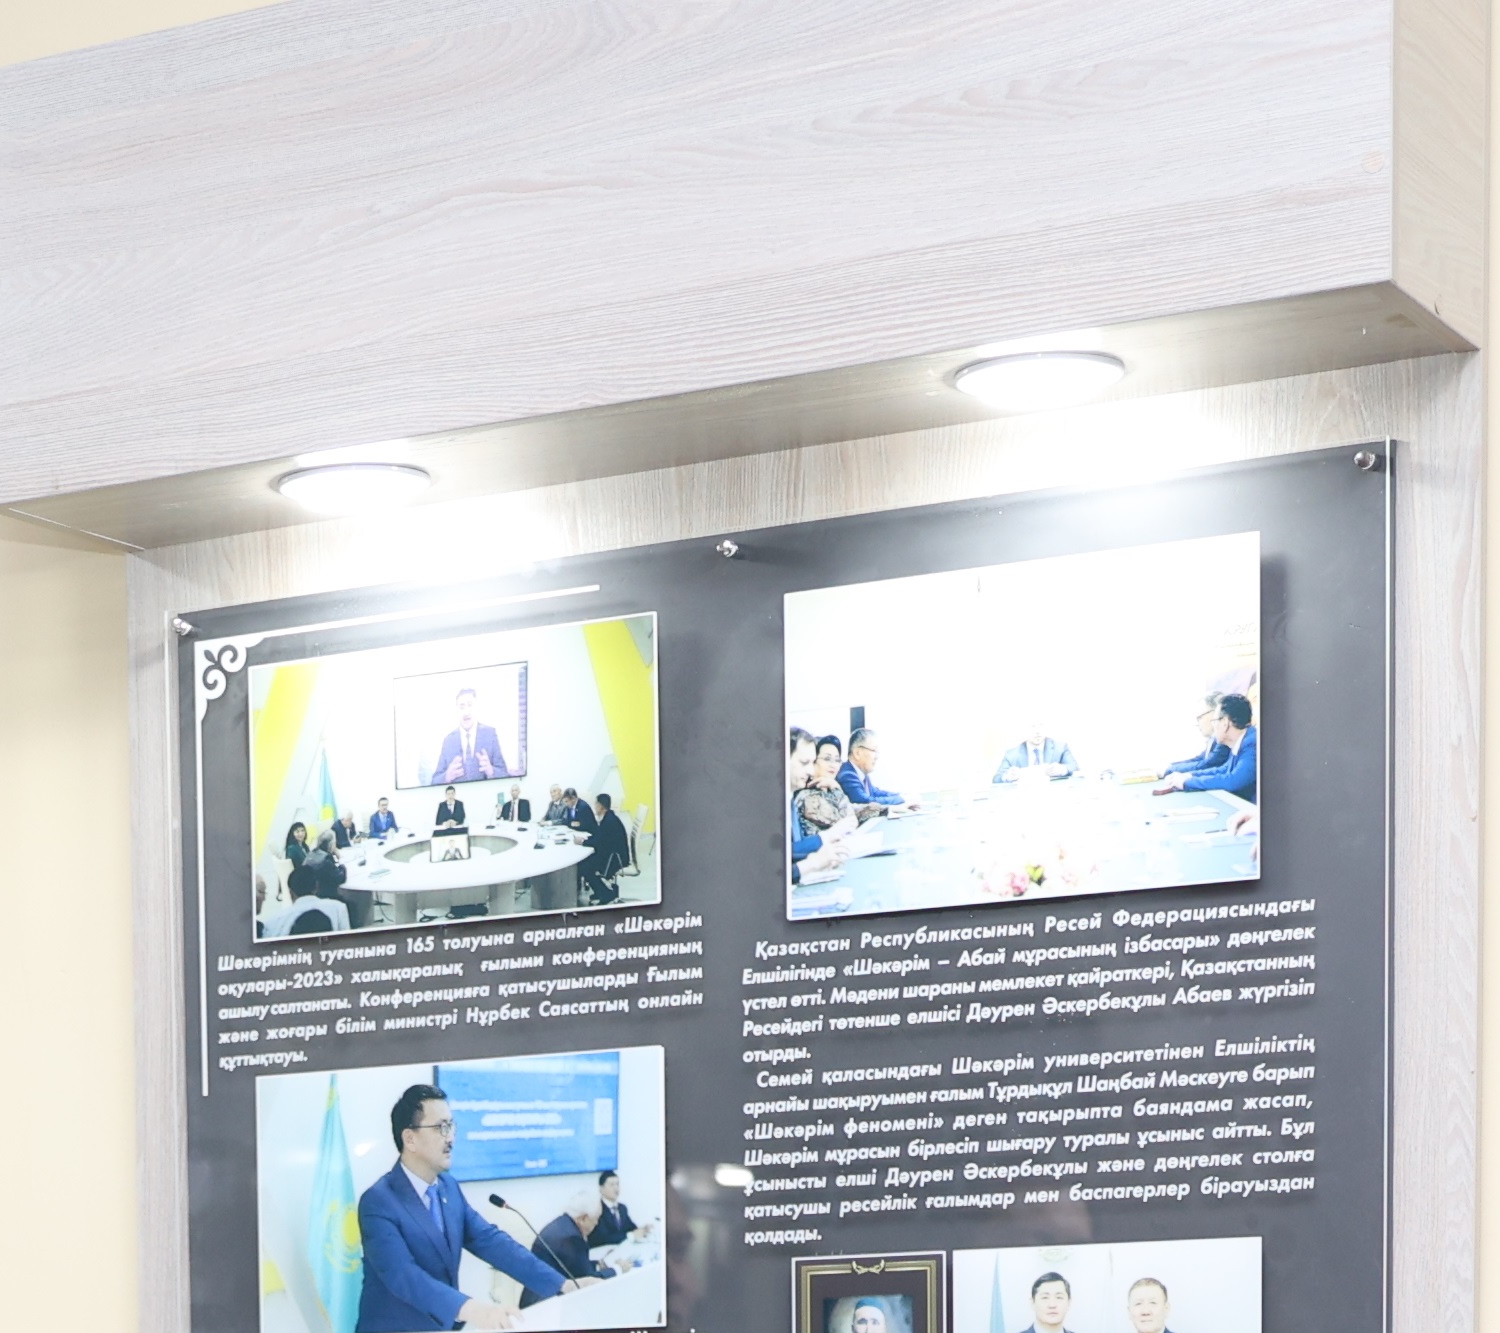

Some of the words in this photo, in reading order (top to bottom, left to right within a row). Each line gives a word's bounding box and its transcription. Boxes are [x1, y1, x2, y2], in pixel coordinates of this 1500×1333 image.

[217, 946, 313, 973] Шәкәрімнің
[319, 943, 397, 967] туғанына
[406, 934, 435, 954] 165
[442, 932, 515, 953] толуына
[522, 923, 606, 948] арналған
[613, 910, 703, 935] «Шәкәрім
[755, 937, 851, 961] Қазақстан
[1044, 911, 1103, 934] Ресей
[350, 961, 464, 985] халықаралық
[480, 954, 544, 973] ғылыми
[742, 995, 788, 1017] үстел
[790, 987, 827, 1008] өтті.
[829, 985, 900, 1006] Мәдени
[902, 980, 977, 1003] шараны
[978, 973, 1065, 994] мемлекет
[1066, 959, 1175, 989] қайраткері,
[1180, 954, 1316, 980] Қазақстанның
[742, 1013, 824, 1038] Ресейдегі
[828, 1012, 901, 1031] төтенше
[906, 1002, 962, 1025] елшісі
[965, 1001, 1036, 1025] Дәурен
[1041, 990, 1167, 1017] Әскербекұлы
[1171, 984, 1233, 1006] Абаев
[1238, 977, 1316, 1004] жүргізіп
[756, 1068, 814, 1089] Семей
[821, 1062, 942, 1086] қаласындағы
[951, 1052, 1035, 1077] Шәкәрім
[1214, 1032, 1316, 1058] Елшіліктің
[742, 1095, 810, 1120] арнайы
[812, 1090, 928, 1114] шақыруымен
[929, 1086, 985, 1104] ғалым
[987, 1080, 1073, 1104] Тұрдықұл
[1076, 1070, 1156, 1094] Шаңбай
[1158, 1068, 1249, 1090] Мәскеуге
[1252, 1061, 1316, 1087] барып
[743, 1117, 835, 1142] «Шәкәрім
[843, 1111, 945, 1140] феномені»
[952, 1111, 1008, 1132] деген
[1016, 1104, 1123, 1127] тақырыпта
[1132, 1096, 1233, 1118] баяндама
[1242, 1093, 1313, 1111] жасап,
[744, 1145, 819, 1170] Шәкәрім
[824, 1144, 901, 1167] мұрасын
[907, 1135, 980, 1162] бірлесіп
[986, 1135, 1057, 1156] шығару
[1062, 1131, 1131, 1154] туралы
[1136, 1126, 1205, 1150] ұсыныс
[1211, 1120, 1272, 1140] айтты.
[1280, 1116, 1315, 1141] Бұл
